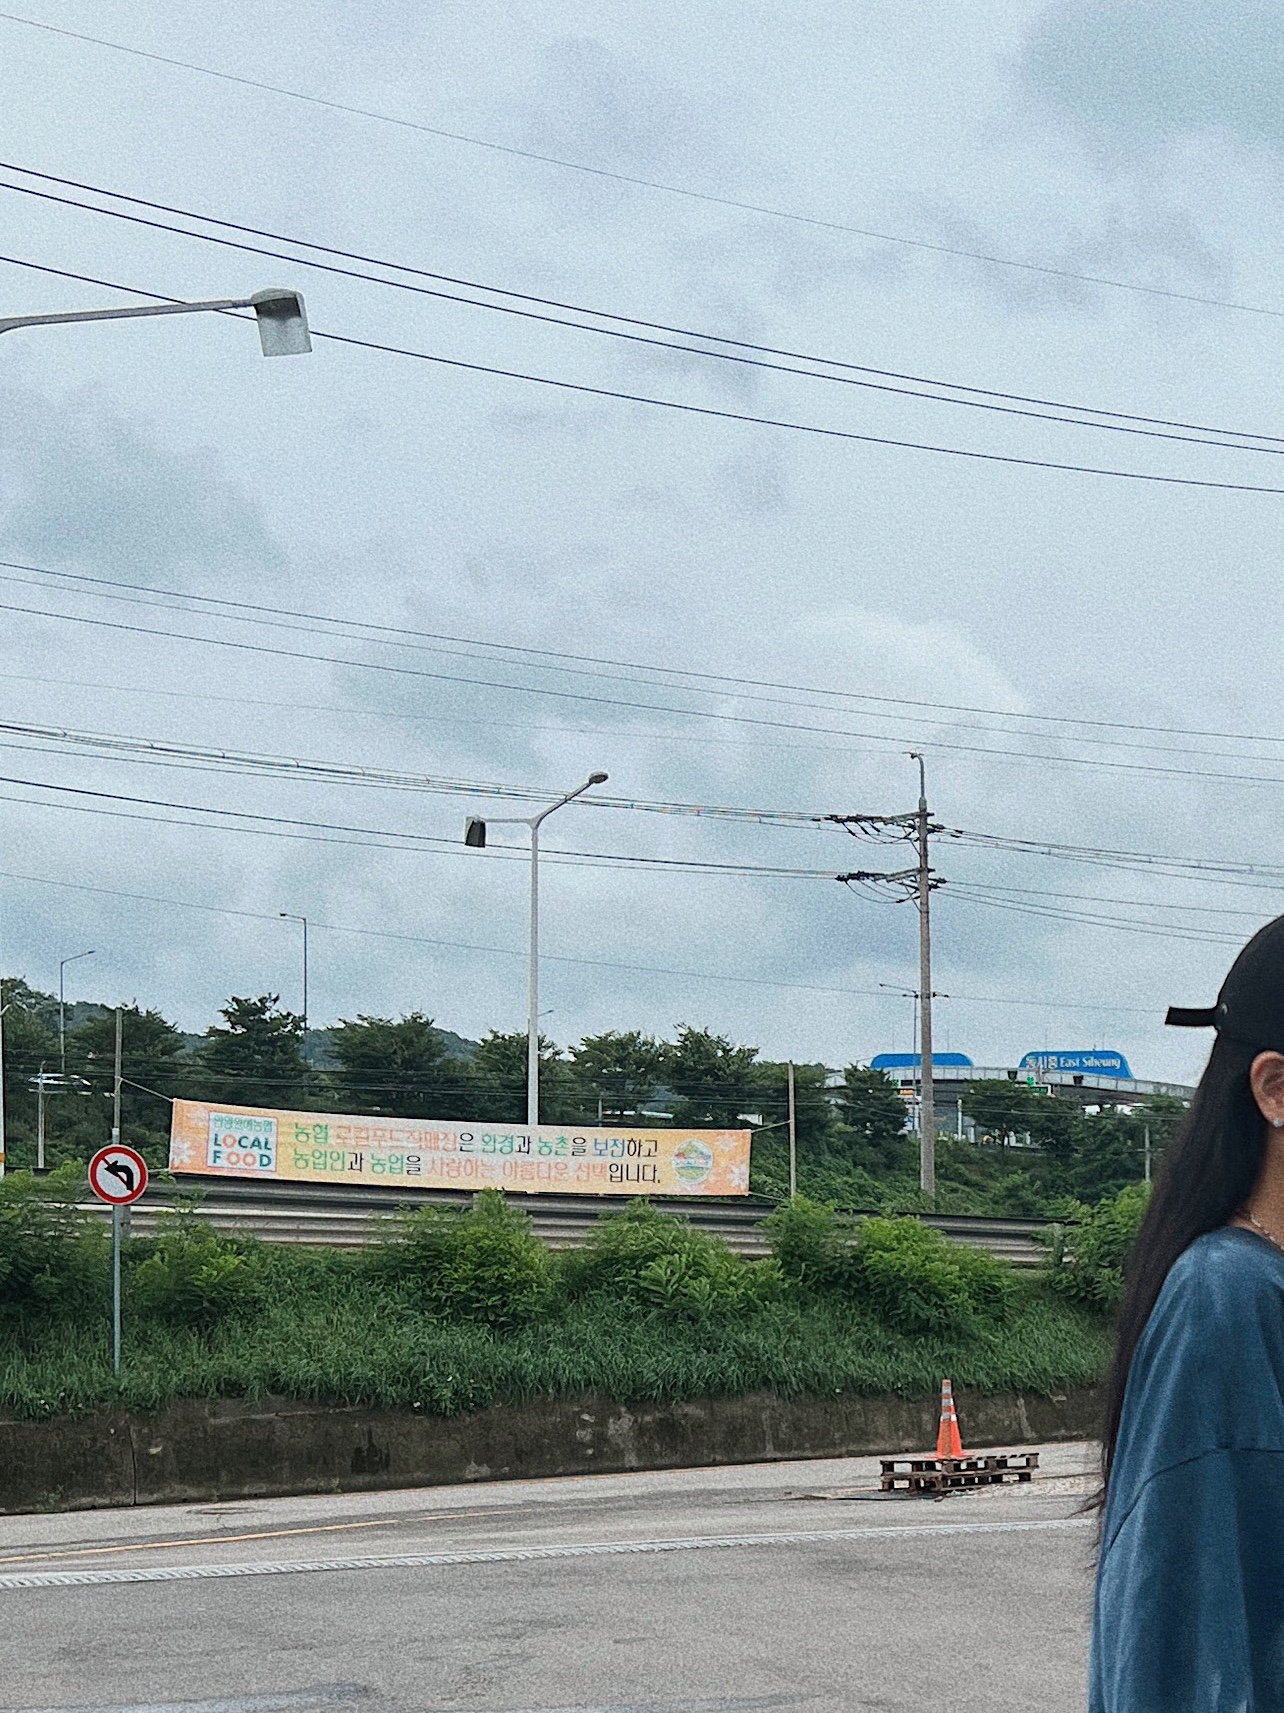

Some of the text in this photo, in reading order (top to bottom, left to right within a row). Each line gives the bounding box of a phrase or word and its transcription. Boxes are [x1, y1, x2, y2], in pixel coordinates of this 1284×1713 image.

[1060, 1056, 1080, 1068] East
[213, 1133, 272, 1151] LOCAL
[294, 1122, 328, 1144] 농협
[481, 1132, 532, 1155] 환경과
[538, 1135, 587, 1157] 농촌을
[592, 1137, 659, 1158] 보전하고
[212, 1150, 272, 1167] FOOD
[293, 1148, 364, 1172] 농업인과
[370, 1153, 421, 1176] 농업을
[428, 1157, 496, 1180] 사랑하는
[501, 1160, 569, 1182] 아름다운
